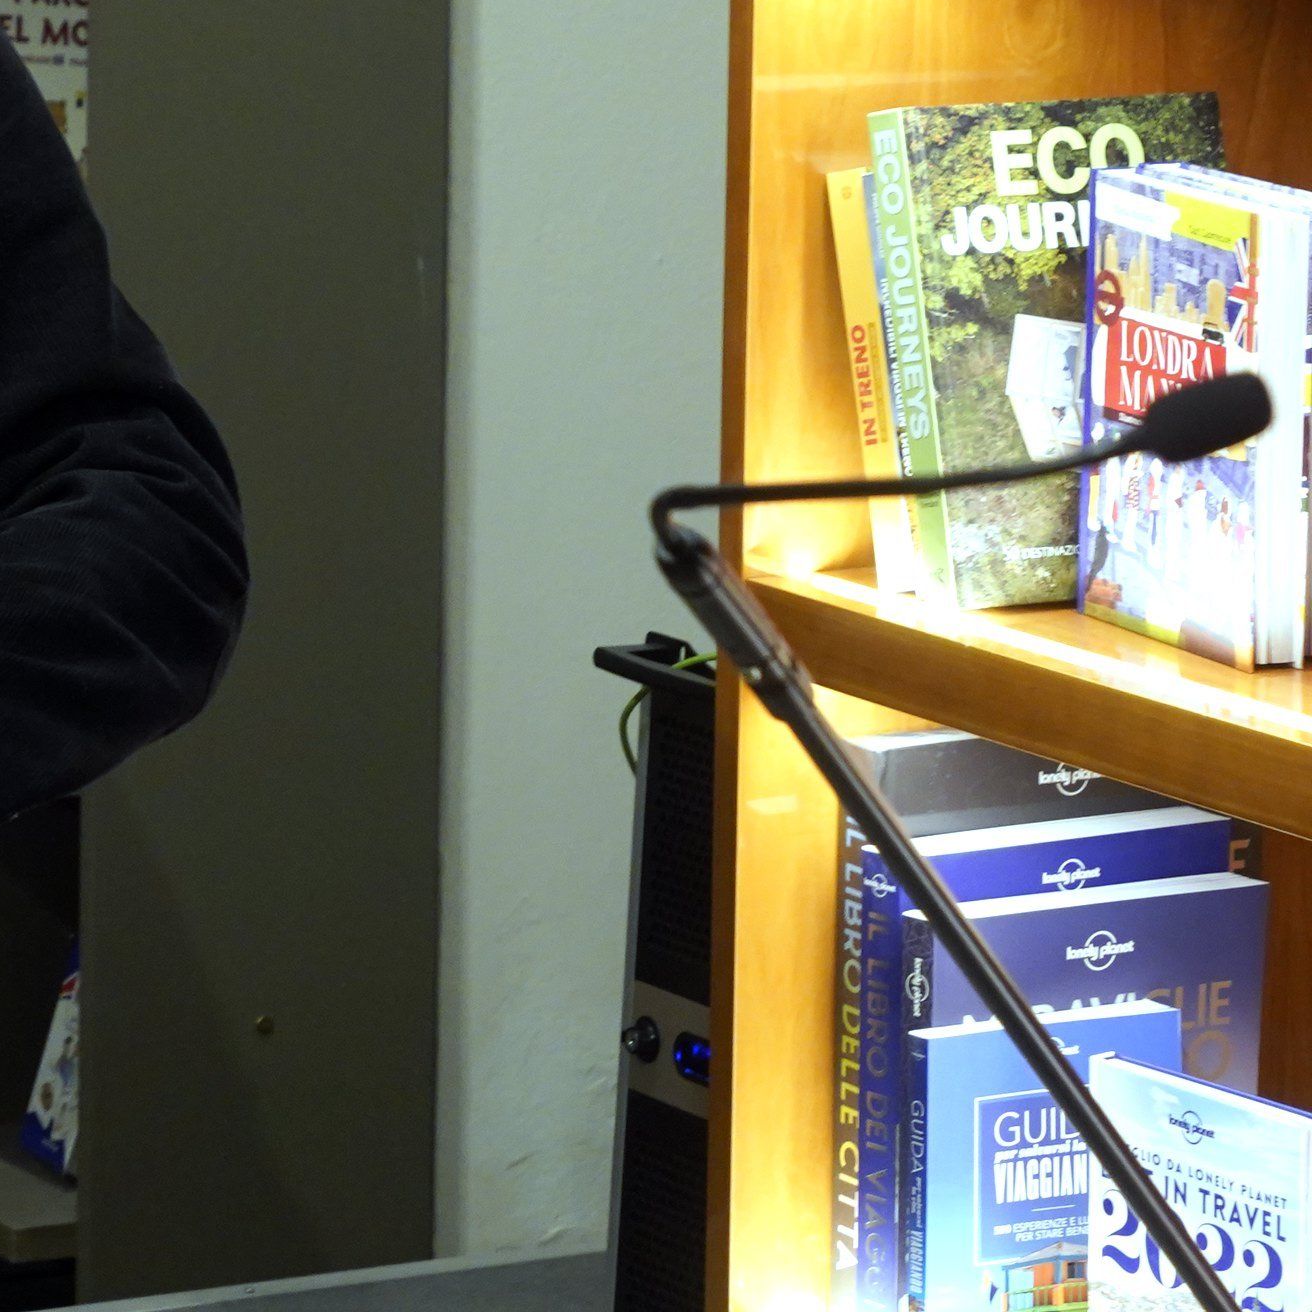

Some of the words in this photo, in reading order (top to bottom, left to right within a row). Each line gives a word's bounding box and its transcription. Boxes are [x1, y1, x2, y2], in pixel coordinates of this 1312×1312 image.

[874, 128, 905, 216] ECO
[989, 122, 1146, 197] ECO
[850, 323, 875, 414] TRENO
[884, 230, 931, 441] JOURNEYS
[1120, 319, 1214, 383] LONDRA
[863, 417, 879, 447] IN
[1041, 870, 1074, 887] lonely
[1074, 866, 1102, 882] planet
[842, 864, 864, 996] LIBRO
[1065, 944, 1101, 962] lonely
[1100, 939, 1135, 957] planet
[838, 1003, 863, 1130] DELLE
[909, 1099, 926, 1174] GUIDA
[993, 1153, 1088, 1205] VIAGGIAN
[1166, 1158, 1183, 1175] DA
[1188, 1165, 1235, 1192] LONELY
[1240, 1183, 1288, 1210] PLANET
[1198, 1187, 1287, 1243] TRAVEL
